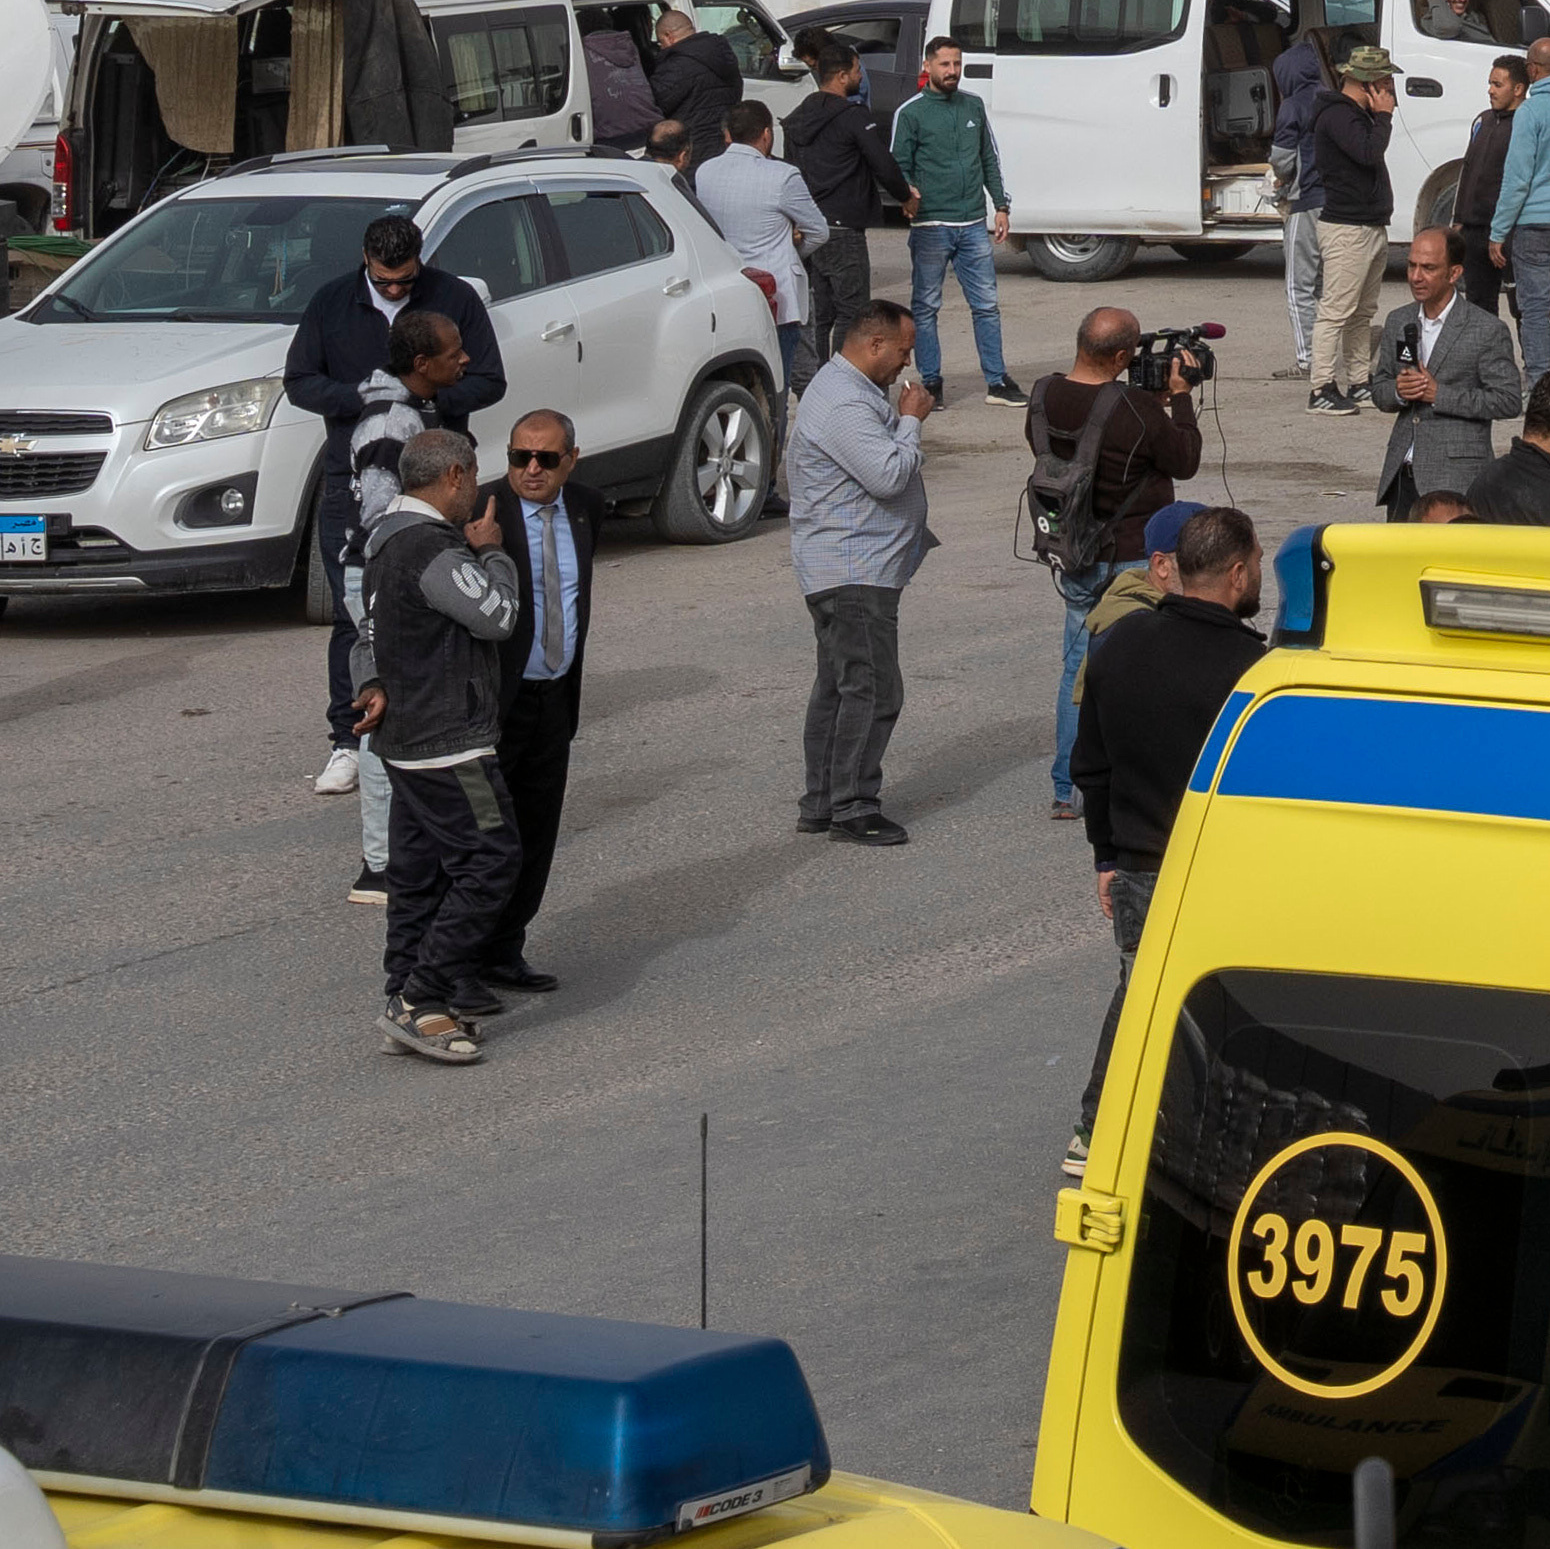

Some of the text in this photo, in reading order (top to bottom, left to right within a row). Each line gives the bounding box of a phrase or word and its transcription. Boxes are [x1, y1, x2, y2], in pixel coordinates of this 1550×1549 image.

[12, 520, 37, 529] مصر
[1247, 1213, 1427, 1317] 3975
[709, 1489, 764, 1515] CODE 3
